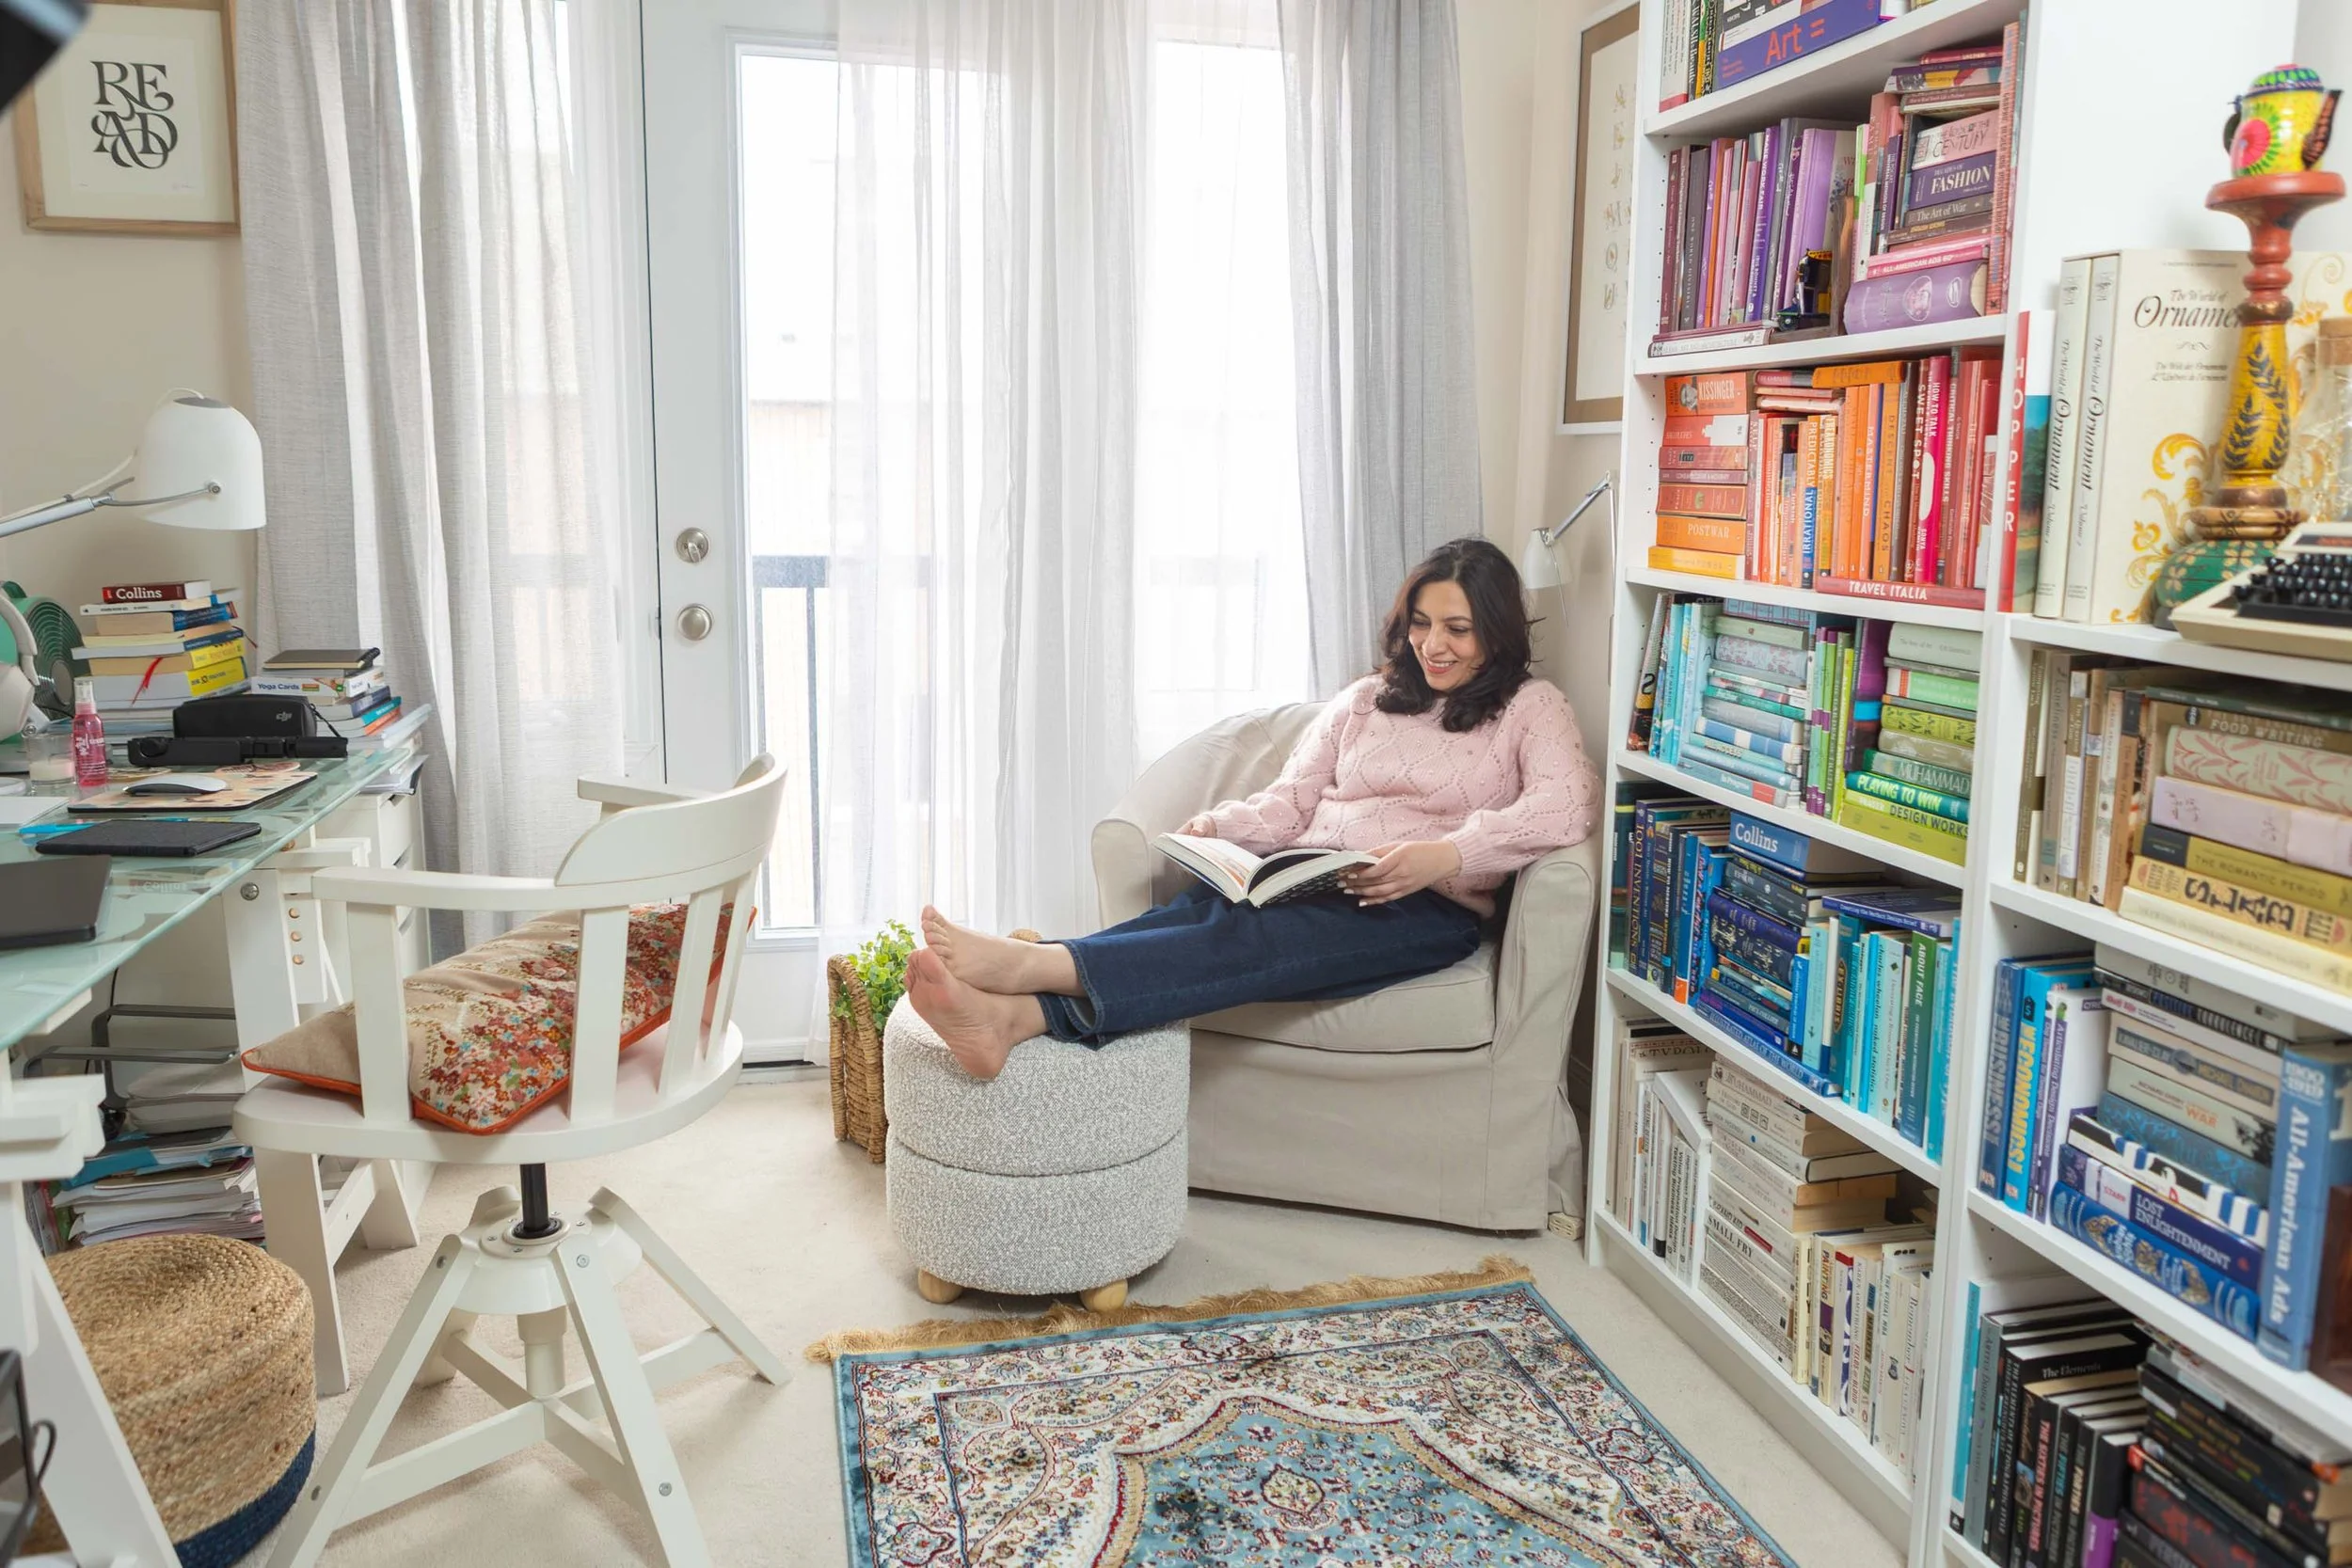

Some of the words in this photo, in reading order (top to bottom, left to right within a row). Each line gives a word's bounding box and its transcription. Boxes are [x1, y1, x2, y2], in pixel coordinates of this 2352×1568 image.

[1764, 24, 1803, 66] Art
[1933, 128, 1989, 158] CENTURY
[1931, 165, 1991, 195] FASHION
[1916, 210, 1932, 222] The
[1931, 208, 1943, 218] Art
[1943, 205, 1951, 215] of
[1950, 201, 1966, 214] War
[2135, 295, 2240, 328] Orname
[1698, 380, 1735, 400] KISSINGER
[1932, 382, 1941, 402] HOW
[1948, 384, 1957, 421] CRITICAL
[1915, 385, 1925, 434] SWEET
[1930, 417, 1938, 436] TALK
[1805, 421, 1817, 487] PREDICTABLY
[1823, 418, 1835, 480] FREAKONOMICS
[1945, 426, 1954, 468] THINKING
[2004, 356, 2026, 532] HOPPER
[2048, 398, 2072, 491] Ornament
[2081, 396, 2105, 490] Ornament
[1863, 426, 1874, 517] MASTERMIND
[1943, 471, 1951, 501] SKILLS
[1688, 523, 1730, 539] POSTWAR
[1803, 490, 1814, 553] IRRATIONAL
[1882, 500, 1891, 551] CHAOS
[116, 587, 162, 599] Collins
[1849, 580, 1886, 596] TRAVEL
[1891, 584, 1928, 600] ITALIA
[2210, 720, 2249, 736] FOOD
[2255, 726, 2324, 748] WRITING
[1857, 775, 1899, 800] PLAYING
[1901, 786, 1915, 804] TO
[1917, 791, 1942, 811] WIN
[1898, 762, 1969, 795] MUHAMMAD
[1889, 804, 1928, 825] DESIGN
[1635, 824, 1644, 857] 1001
[1735, 822, 1778, 852] Collins
[2195, 855, 2216, 870] THE
[2219, 861, 2277, 886] ROMANTIC
[2280, 879, 2327, 899] PERIOD
[1631, 863, 1641, 946] INVENTIONS
[1915, 943, 1926, 979] ABOUT
[1915, 981, 1924, 1006] FACE
[1780, 1057, 1804, 1078] WORLD
[2051, 1023, 2065, 1079] Articulating
[2047, 1081, 2059, 1113] Design
[2185, 1103, 2218, 1128] WAR
[2043, 1114, 2056, 1158] Decisions
[1674, 1177, 1682, 1224] Proposition
[2137, 1194, 2165, 1213] LOST
[2276, 1106, 2310, 1271] All-American
[1708, 1215, 1735, 1244] SMALL
[1737, 1239, 1754, 1258] FRY
[2135, 1210, 2231, 1270] ENLIGHTENMENT
[1820, 1250, 1830, 1301] PAINTING
[2269, 1275, 2291, 1324] Ads
[1904, 1297, 1917, 1363] Remember
[1852, 1344, 1861, 1370] FIELDS
[2011, 1362, 2020, 1381] THE
[2042, 1368, 2058, 1378] The
[1851, 1380, 1859, 1404] BLOOD
[2008, 1384, 2017, 1427] ELEMENTS
[2040, 1419, 2050, 1442] THE
[2060, 1432, 2069, 1452] THE
[2036, 1444, 2049, 1483] SIXTIES
[2076, 1444, 2086, 1465] THE
[2000, 1443, 2012, 1504] TYPOGRAPHIC
[2055, 1454, 2068, 1496] FIFTIES
[2070, 1466, 2084, 1513] FORTIES
[2036, 1486, 2044, 1498] IN
[2054, 1497, 2063, 1509] IN
[2029, 1499, 2043, 1551] PICTURES
[2049, 1511, 2061, 1562] PICTURES
[2064, 1529, 2076, 1568] PICTUR
